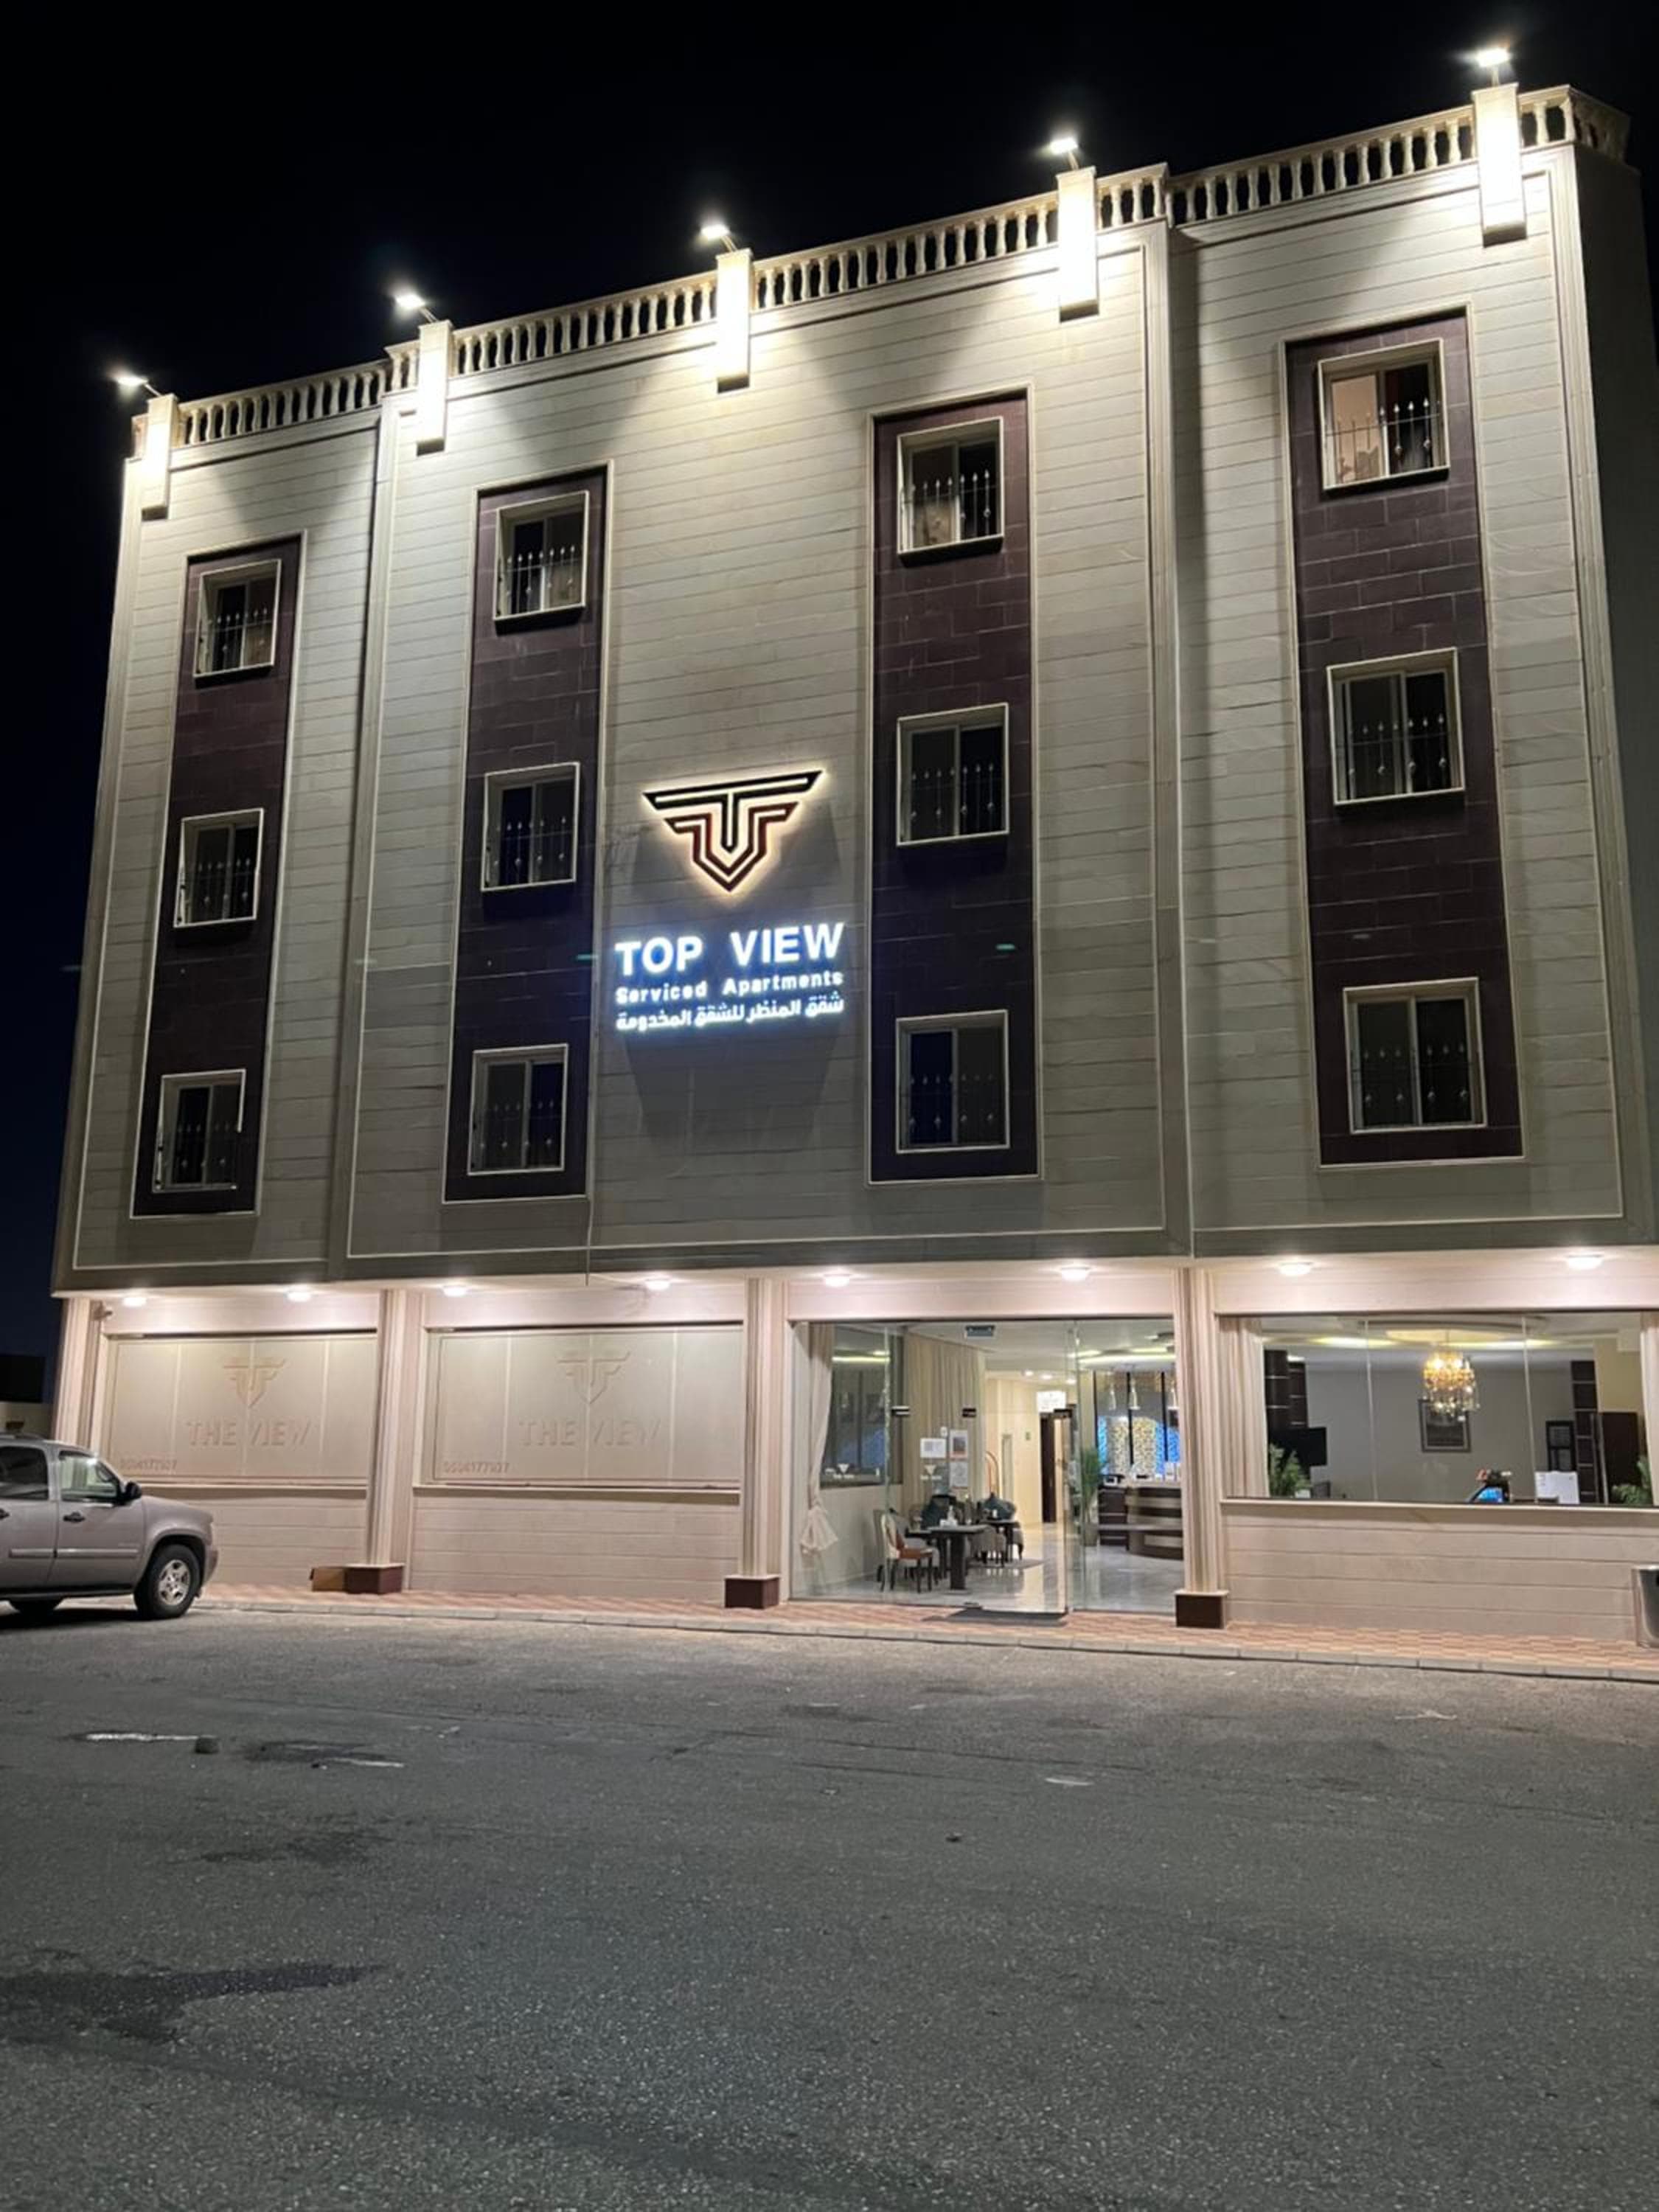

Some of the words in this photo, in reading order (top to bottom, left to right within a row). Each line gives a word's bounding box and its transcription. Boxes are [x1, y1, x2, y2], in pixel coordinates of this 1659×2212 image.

[614, 936, 703, 976] TOP
[730, 922, 845, 967] VIEW
[615, 981, 708, 1005] Serviced
[722, 970, 844, 997] Apartments
[695, 1002, 745, 1027] للشقق
[746, 998, 801, 1023] المنظر
[804, 991, 845, 1018] شقق
[616, 1009, 692, 1032] المخدومة
[186, 1419, 237, 1447] THE
[518, 1420, 576, 1447] THE
